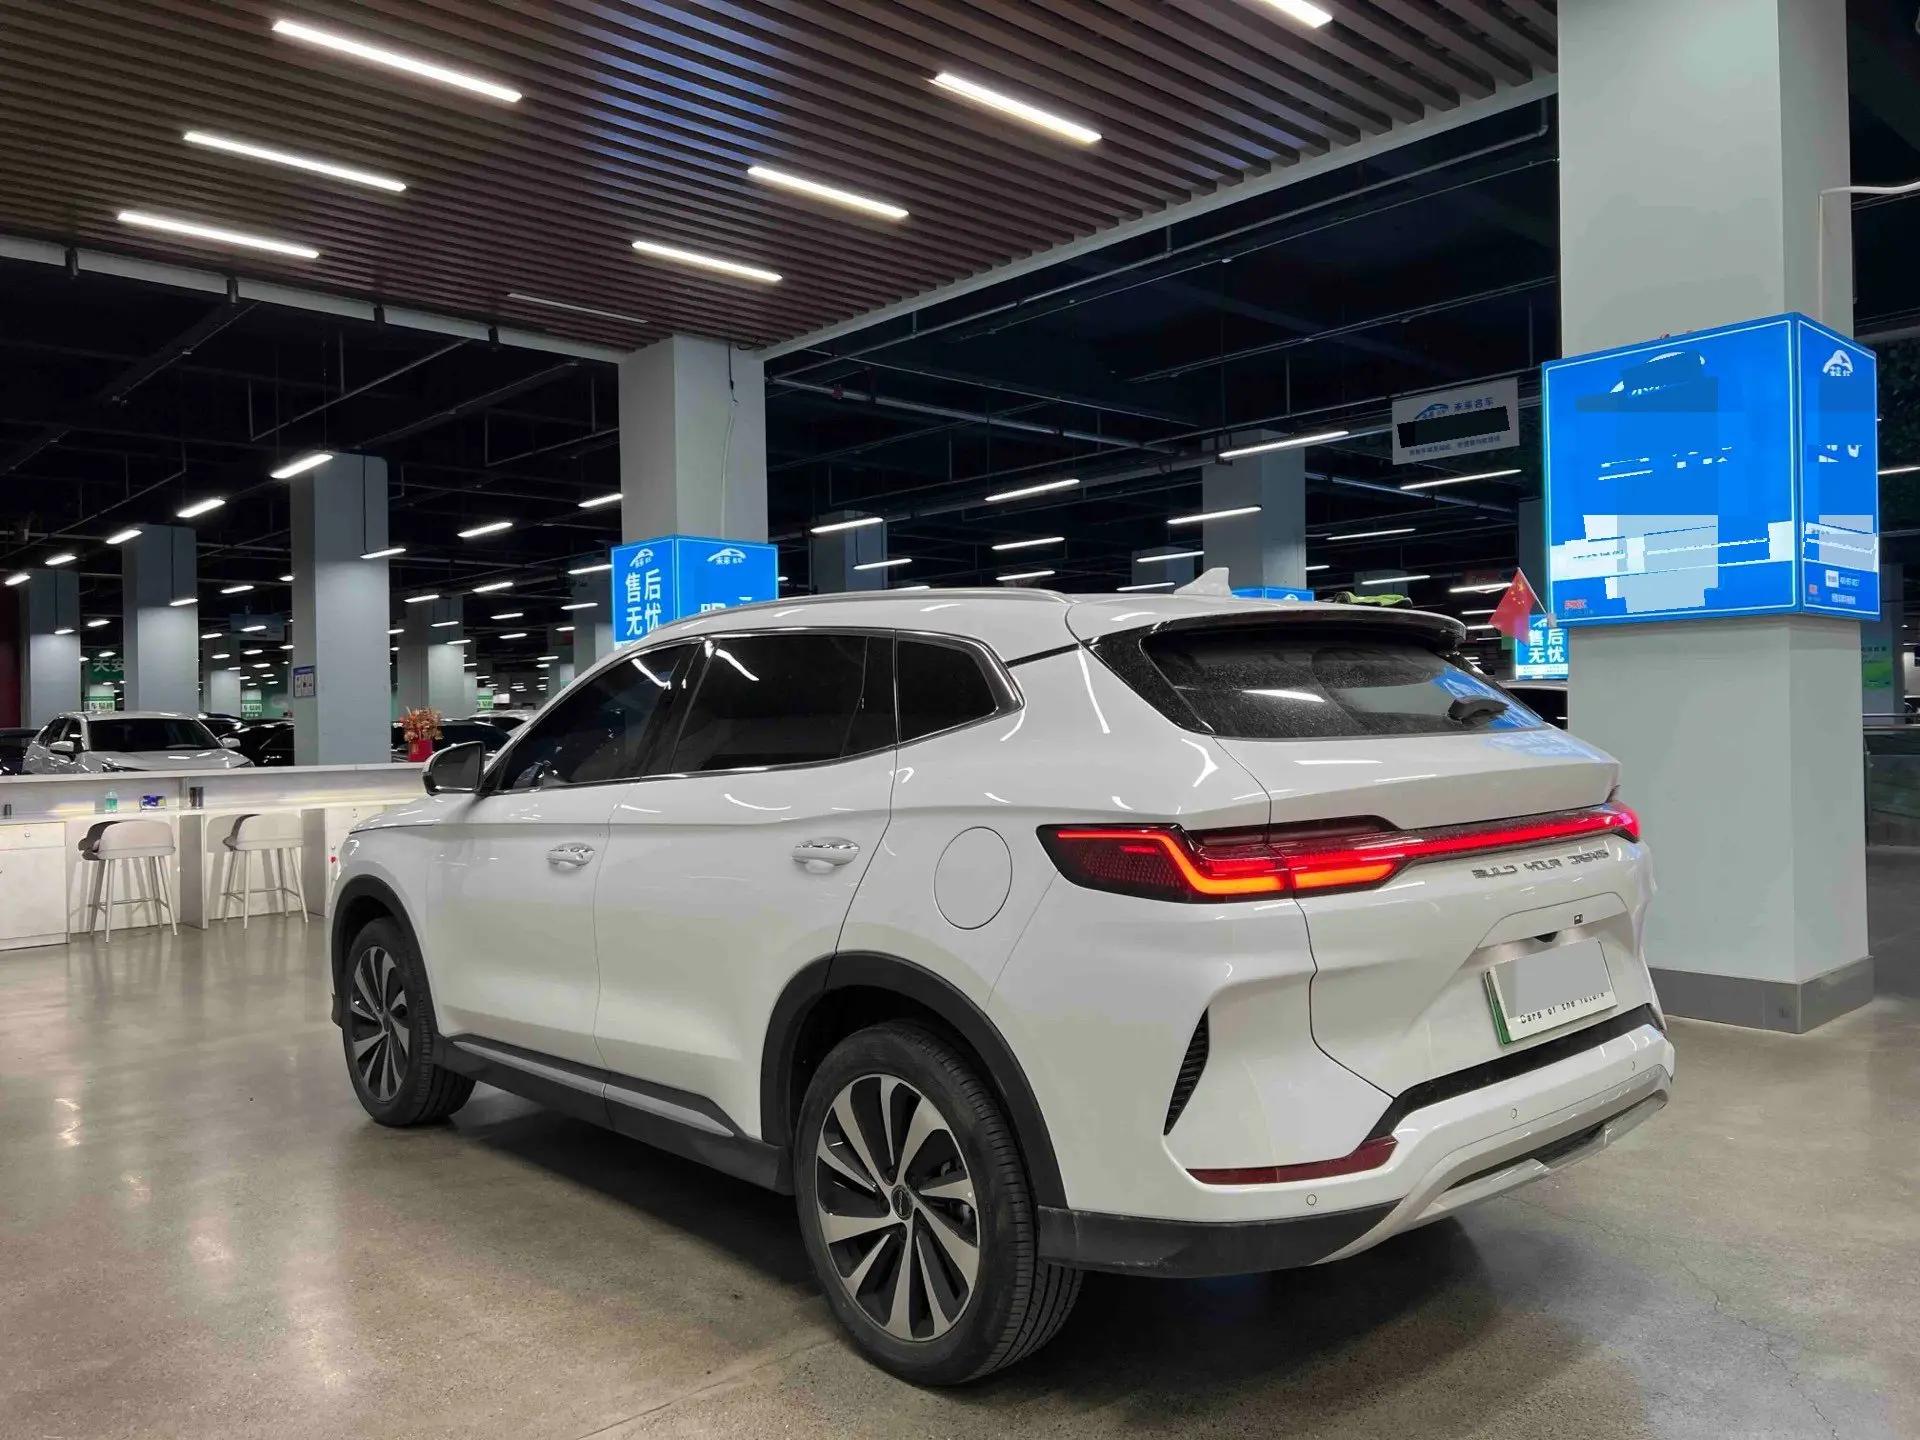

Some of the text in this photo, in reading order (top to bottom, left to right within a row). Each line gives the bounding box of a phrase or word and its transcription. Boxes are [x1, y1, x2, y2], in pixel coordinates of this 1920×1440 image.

[625, 568, 661, 603] 售后
[626, 602, 661, 636] 无忧
[1529, 628, 1564, 646] 售后
[1528, 645, 1565, 664] 无忧
[1519, 1011, 1543, 1024] Cars
